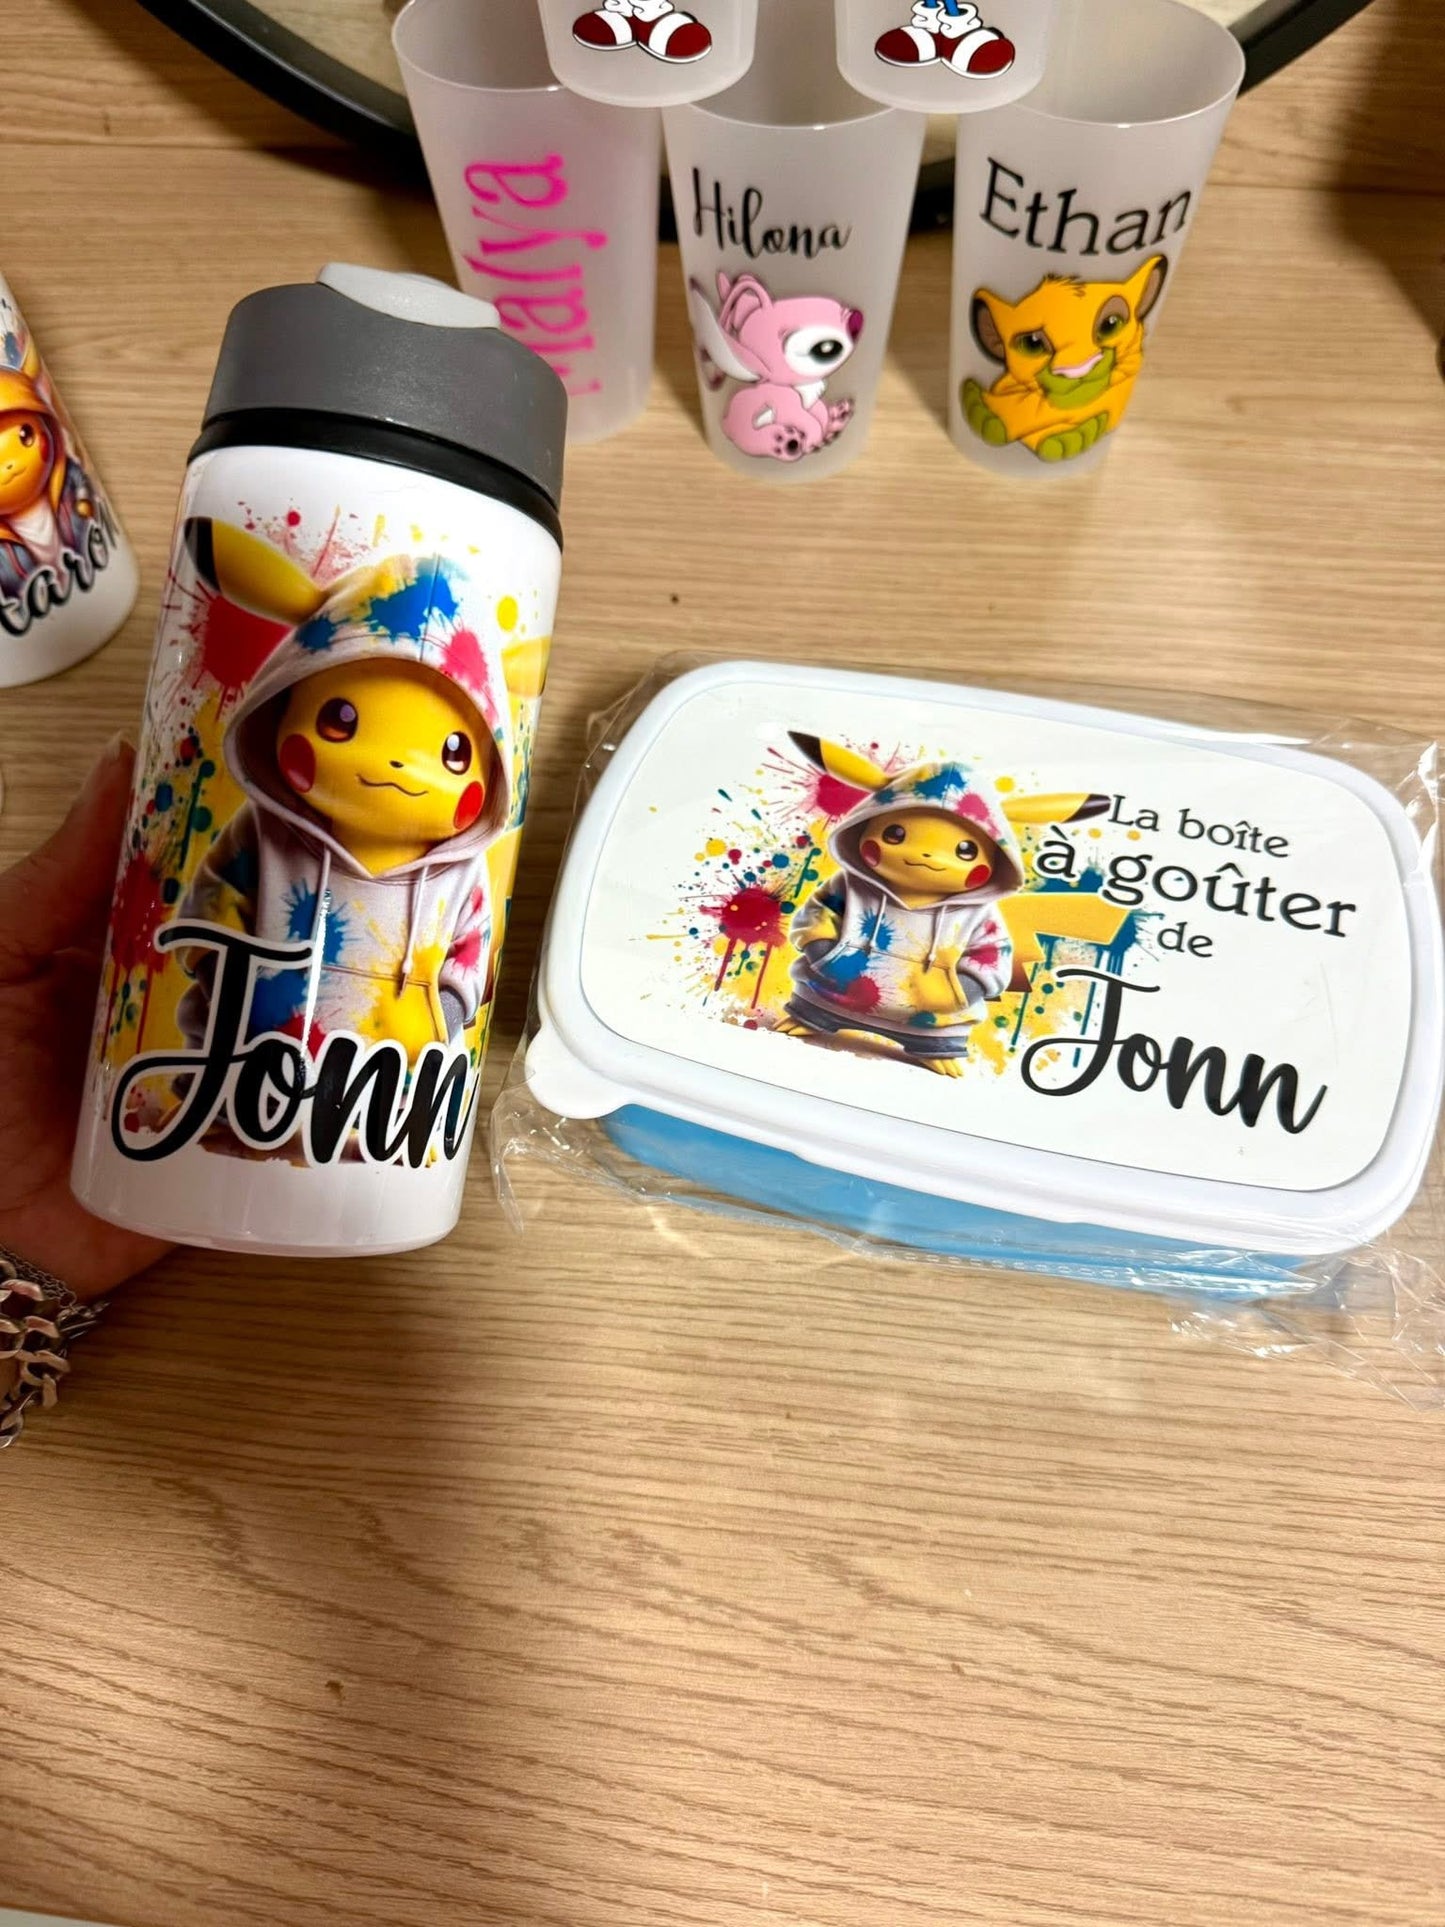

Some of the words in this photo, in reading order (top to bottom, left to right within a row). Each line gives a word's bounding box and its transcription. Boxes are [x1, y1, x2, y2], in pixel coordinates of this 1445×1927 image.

[692, 167, 852, 259] Hilona
[979, 156, 1192, 257] Ethan
[1108, 794, 1160, 832] La
[1178, 808, 1290, 858] boîte
[1037, 825, 1078, 878] à
[1102, 853, 1356, 938] goûter
[1157, 921, 1213, 957] de
[111, 925, 480, 1169] Jonn
[1021, 968, 1327, 1134] Jonn
